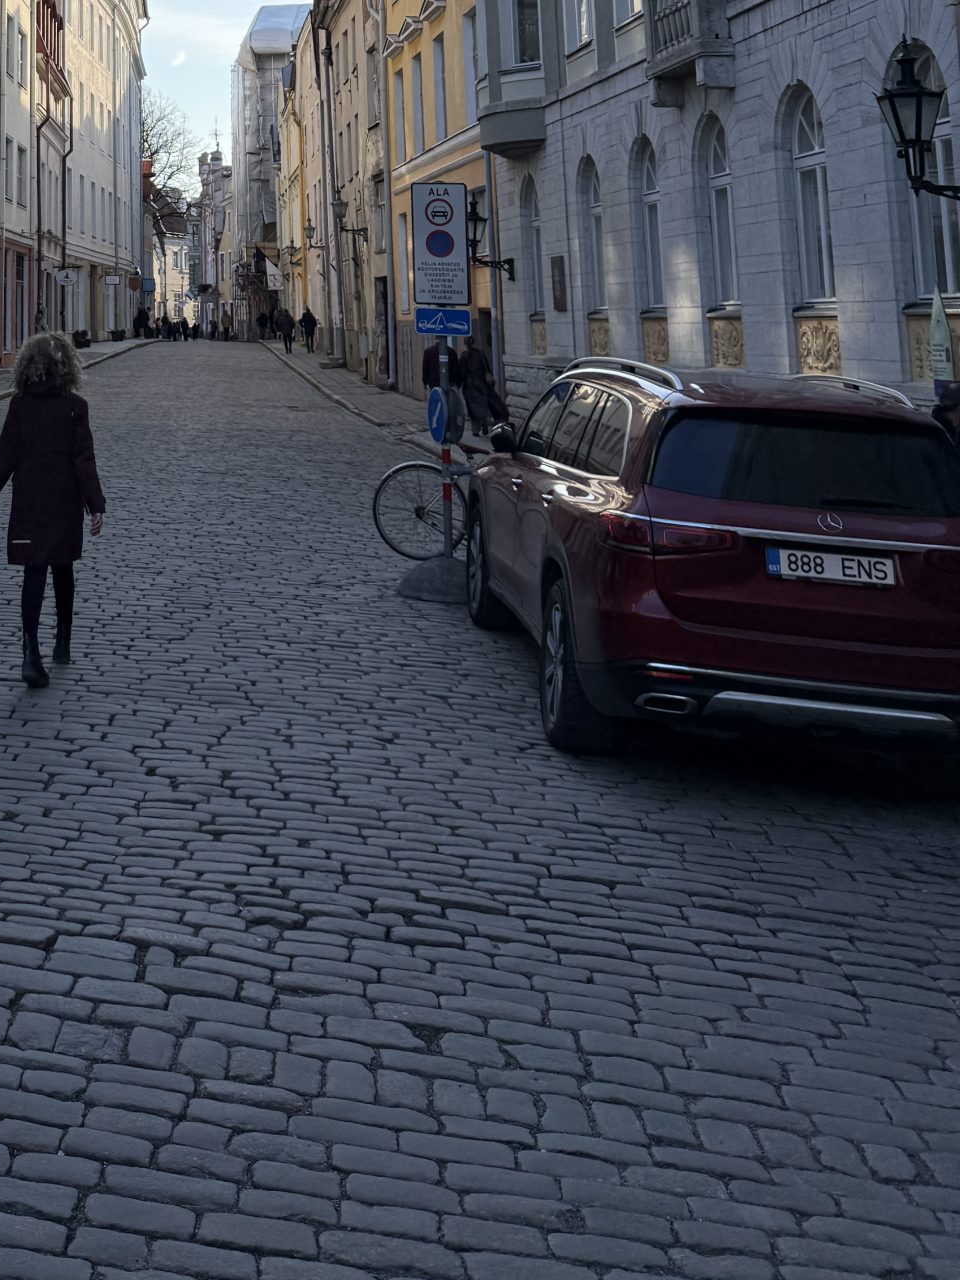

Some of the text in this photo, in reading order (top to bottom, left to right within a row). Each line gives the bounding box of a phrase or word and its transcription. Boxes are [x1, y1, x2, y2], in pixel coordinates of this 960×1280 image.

[428, 187, 450, 197] ALA
[787, 553, 888, 581] 888 ENS
